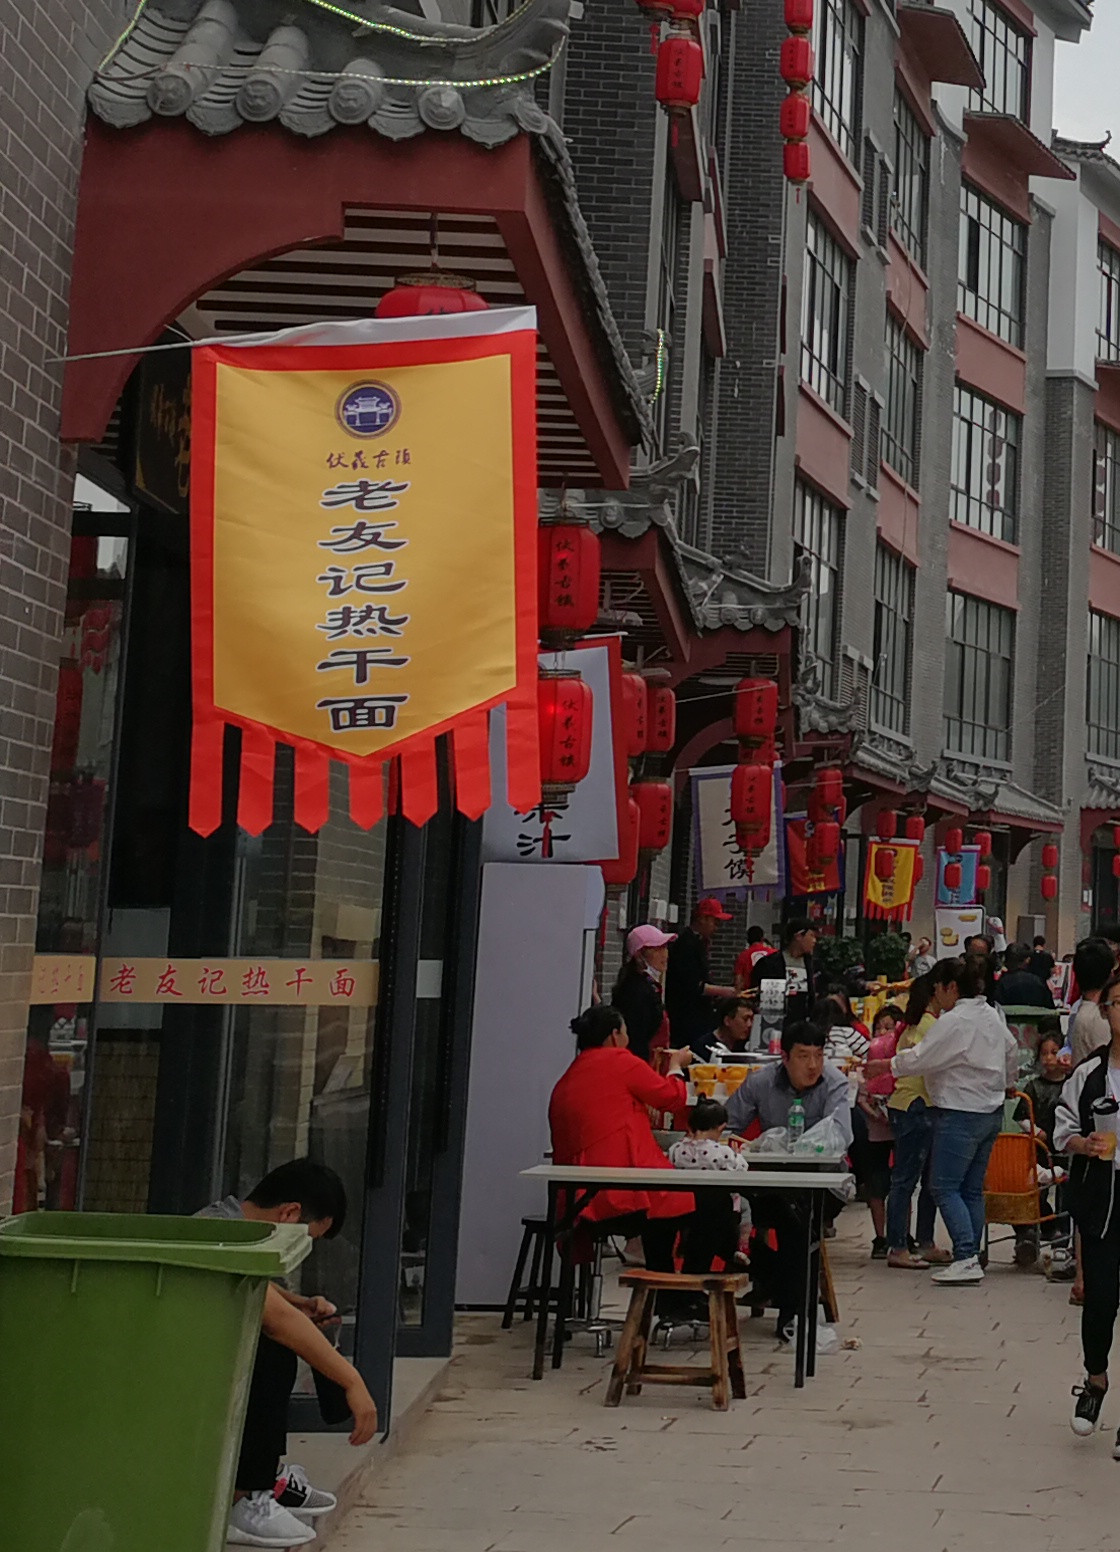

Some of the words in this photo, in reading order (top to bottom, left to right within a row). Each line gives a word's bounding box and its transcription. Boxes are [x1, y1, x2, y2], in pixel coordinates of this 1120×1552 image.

[316, 479, 410, 732] 老友记热干面
[109, 963, 357, 998] 老友记热干面
